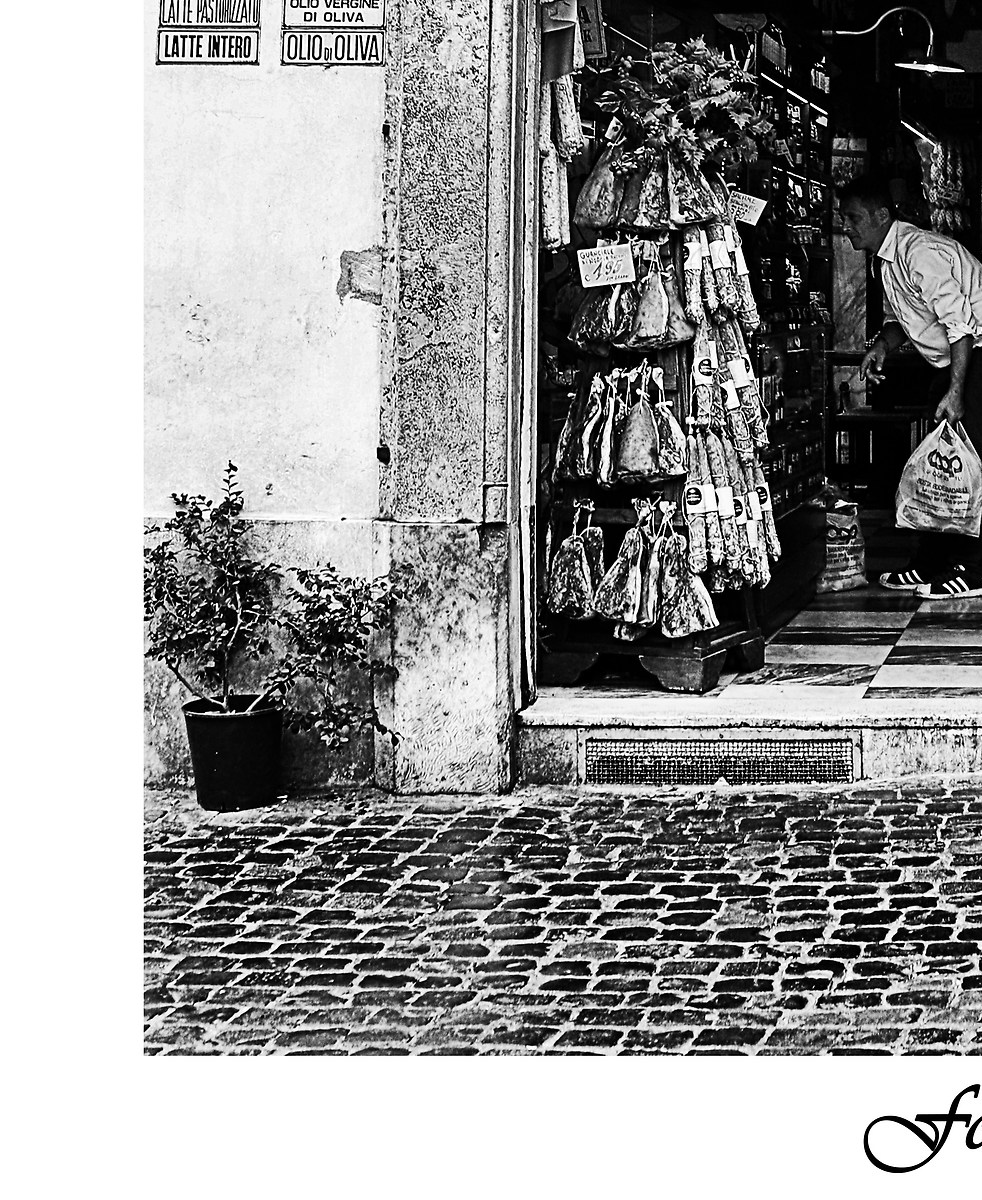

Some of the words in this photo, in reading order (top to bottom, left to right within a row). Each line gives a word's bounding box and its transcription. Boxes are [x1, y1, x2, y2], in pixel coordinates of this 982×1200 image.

[304, 12, 317, 22] DI
[323, 12, 364, 22] OLIVA
[164, 35, 203, 58] LATTE
[207, 35, 252, 59] INTERO
[287, 35, 322, 61] OLIO
[324, 47, 333, 61] DI
[334, 35, 380, 61] OLIVA
